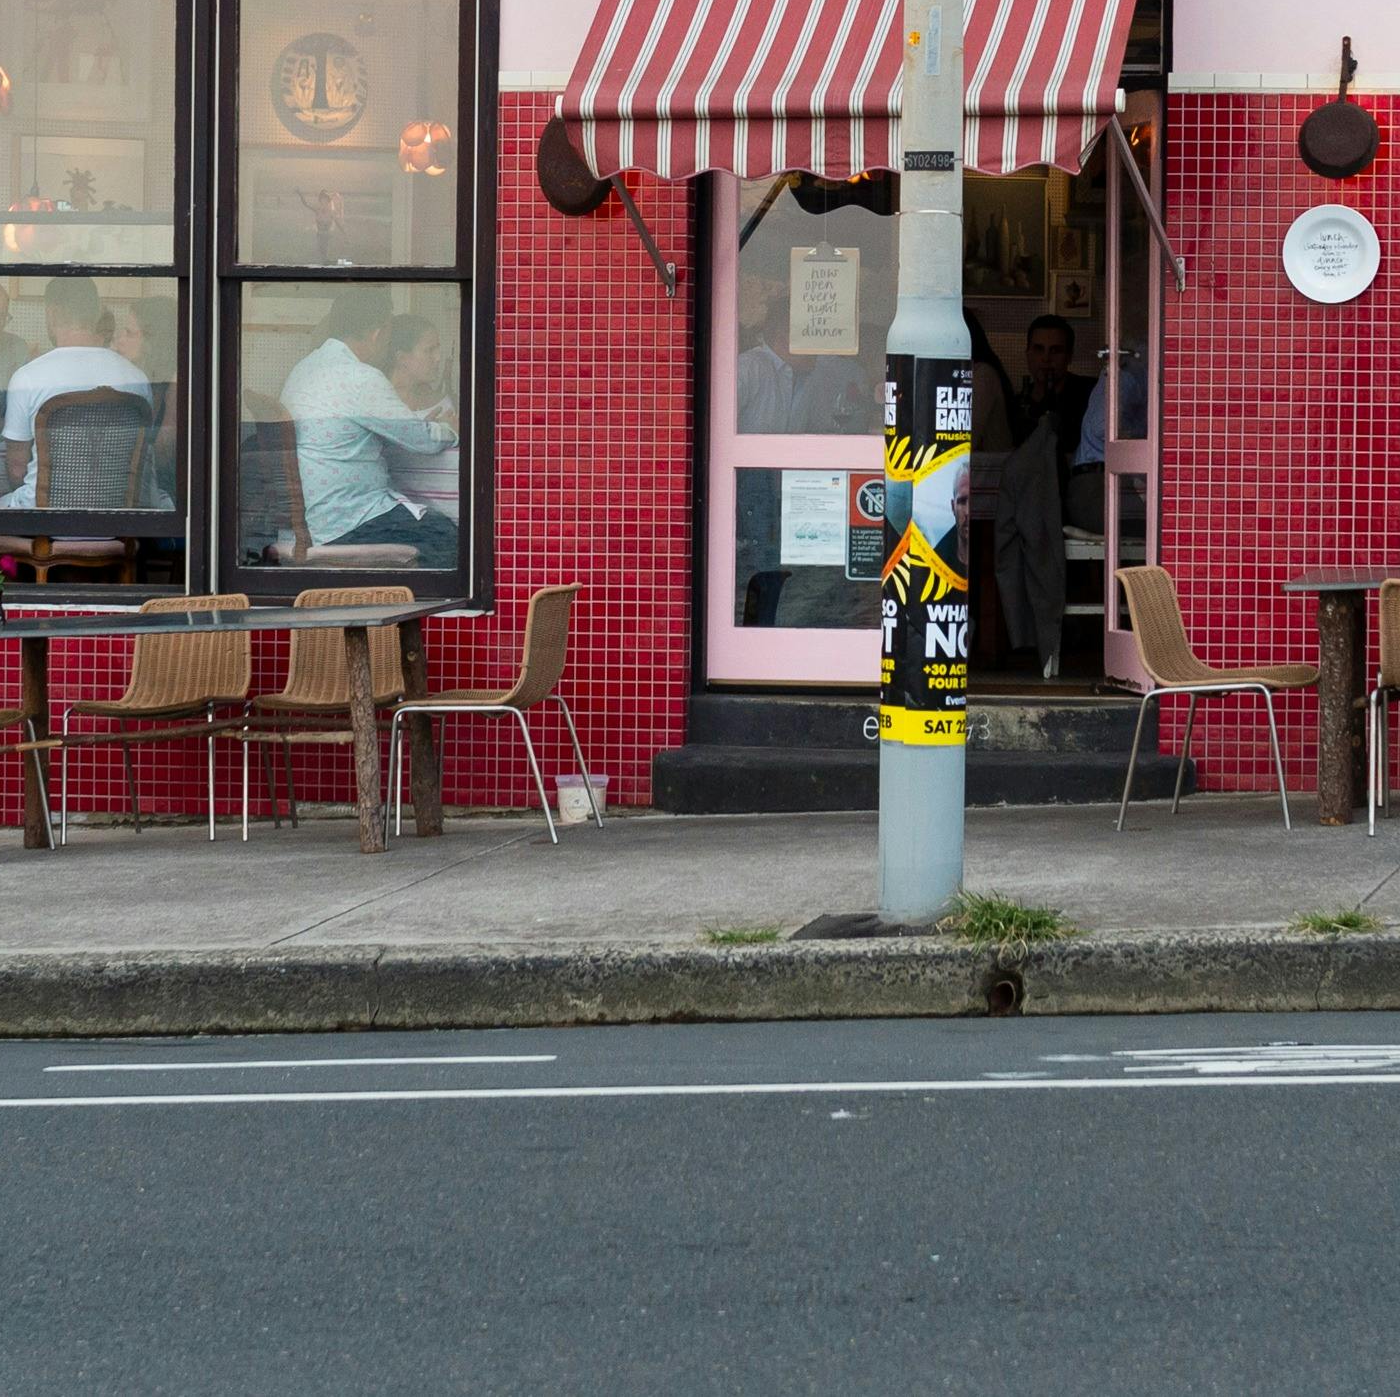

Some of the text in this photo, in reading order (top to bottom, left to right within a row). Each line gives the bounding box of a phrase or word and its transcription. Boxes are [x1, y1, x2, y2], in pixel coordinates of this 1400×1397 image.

[811, 267, 839, 279] now
[805, 280, 833, 293] open
[803, 292, 837, 304] every
[807, 302, 838, 315] night
[810, 313, 828, 327] for
[801, 322, 847, 337] dinner
[923, 664, 949, 676] +30
[928, 677, 961, 690] FOUR
[924, 719, 955, 734] SAT
